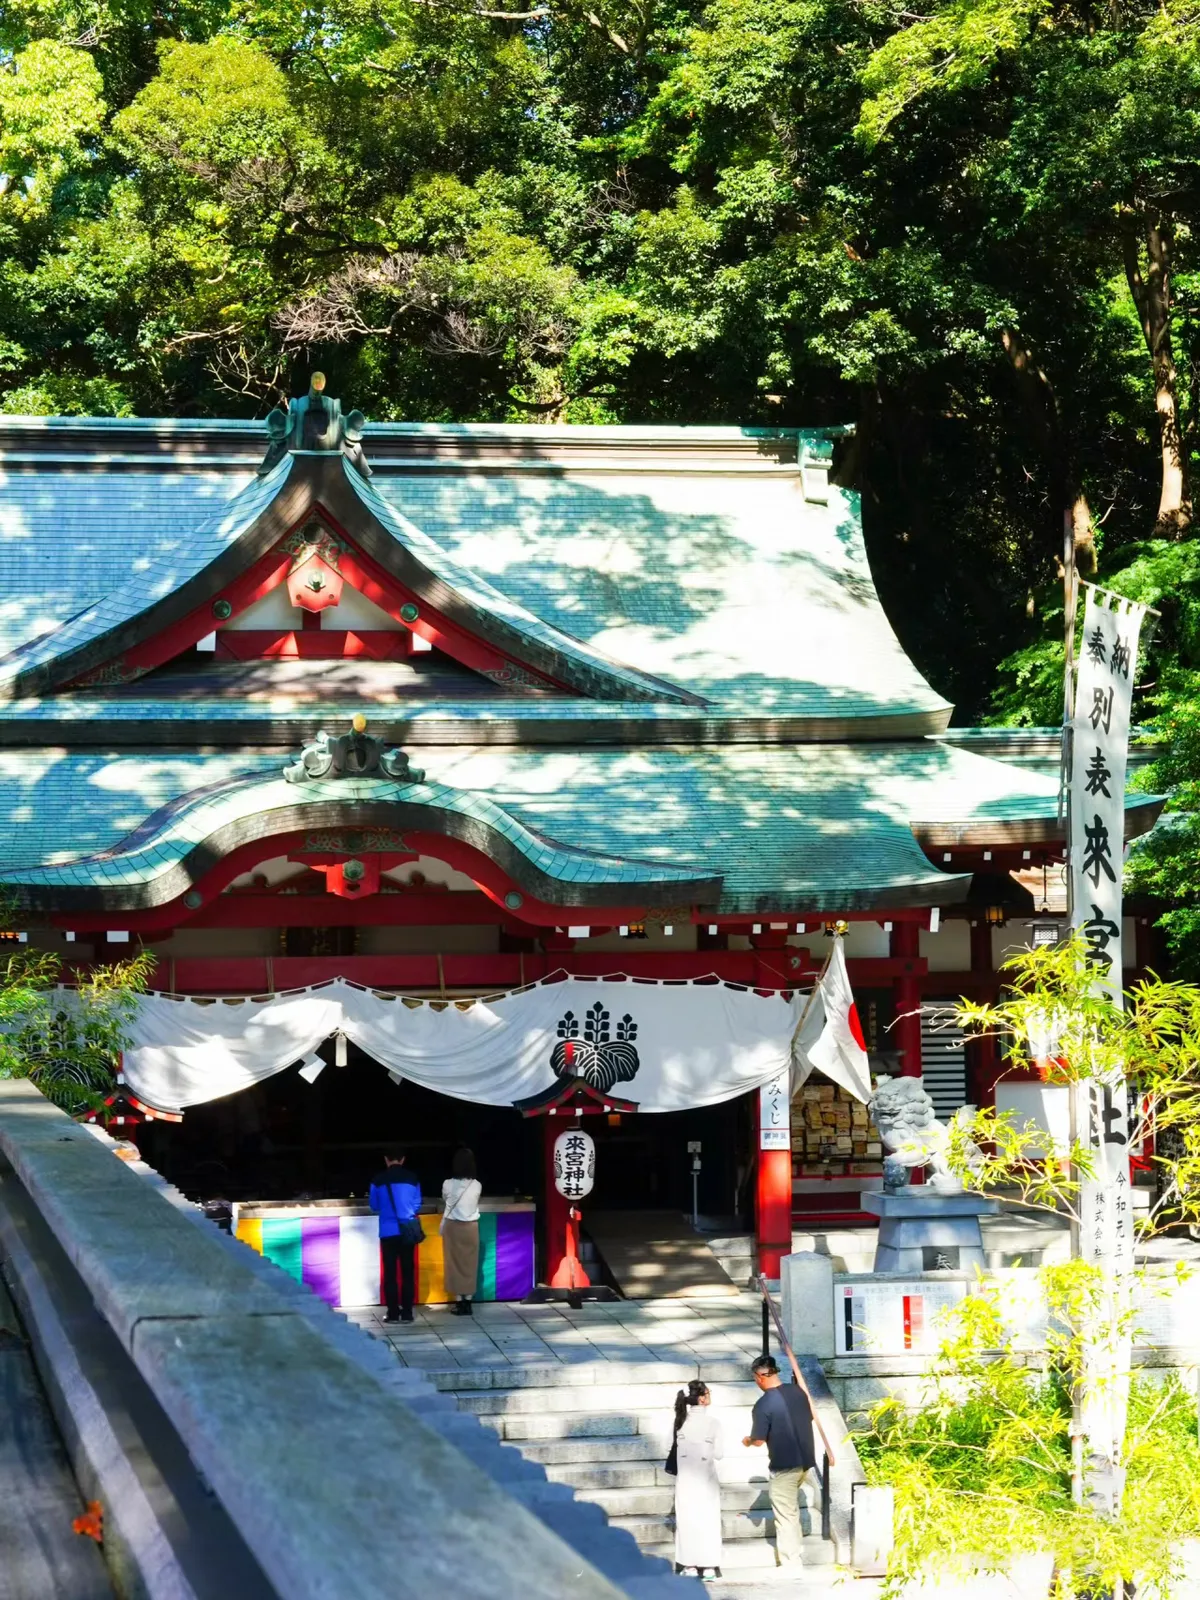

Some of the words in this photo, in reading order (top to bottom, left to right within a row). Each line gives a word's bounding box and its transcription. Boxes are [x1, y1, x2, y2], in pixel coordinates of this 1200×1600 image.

[1086, 625, 1132, 680] 奉納
[1082, 685, 1127, 1148] 別表來宮社
[563, 1135, 586, 1197] 來宮神社
